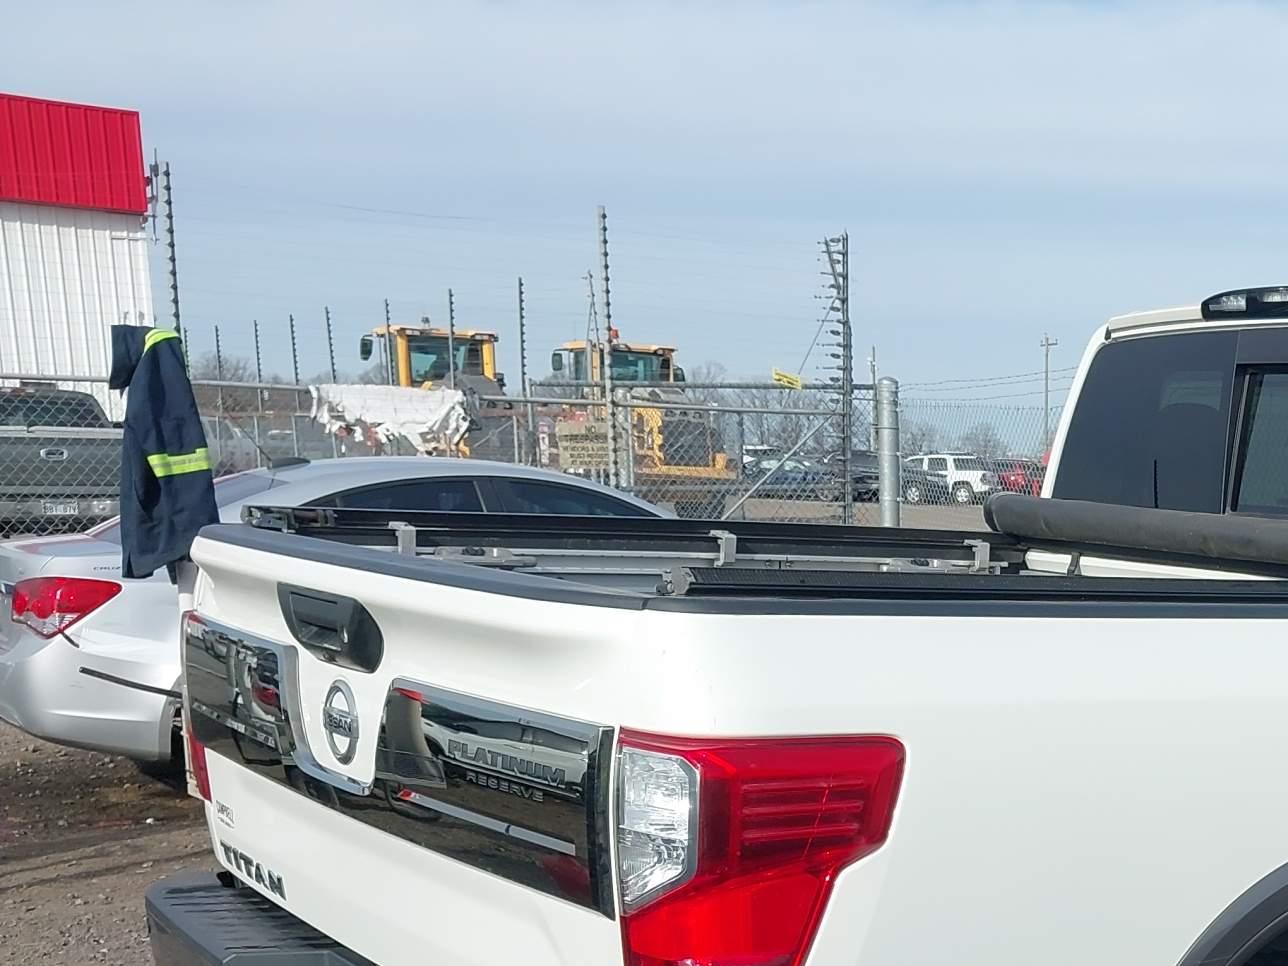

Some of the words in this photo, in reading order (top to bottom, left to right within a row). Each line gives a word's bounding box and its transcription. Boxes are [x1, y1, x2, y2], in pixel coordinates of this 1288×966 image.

[447, 739, 567, 788] PLATINUM
[465, 771, 545, 802] RESERVE
[219, 840, 288, 902] TITAN
